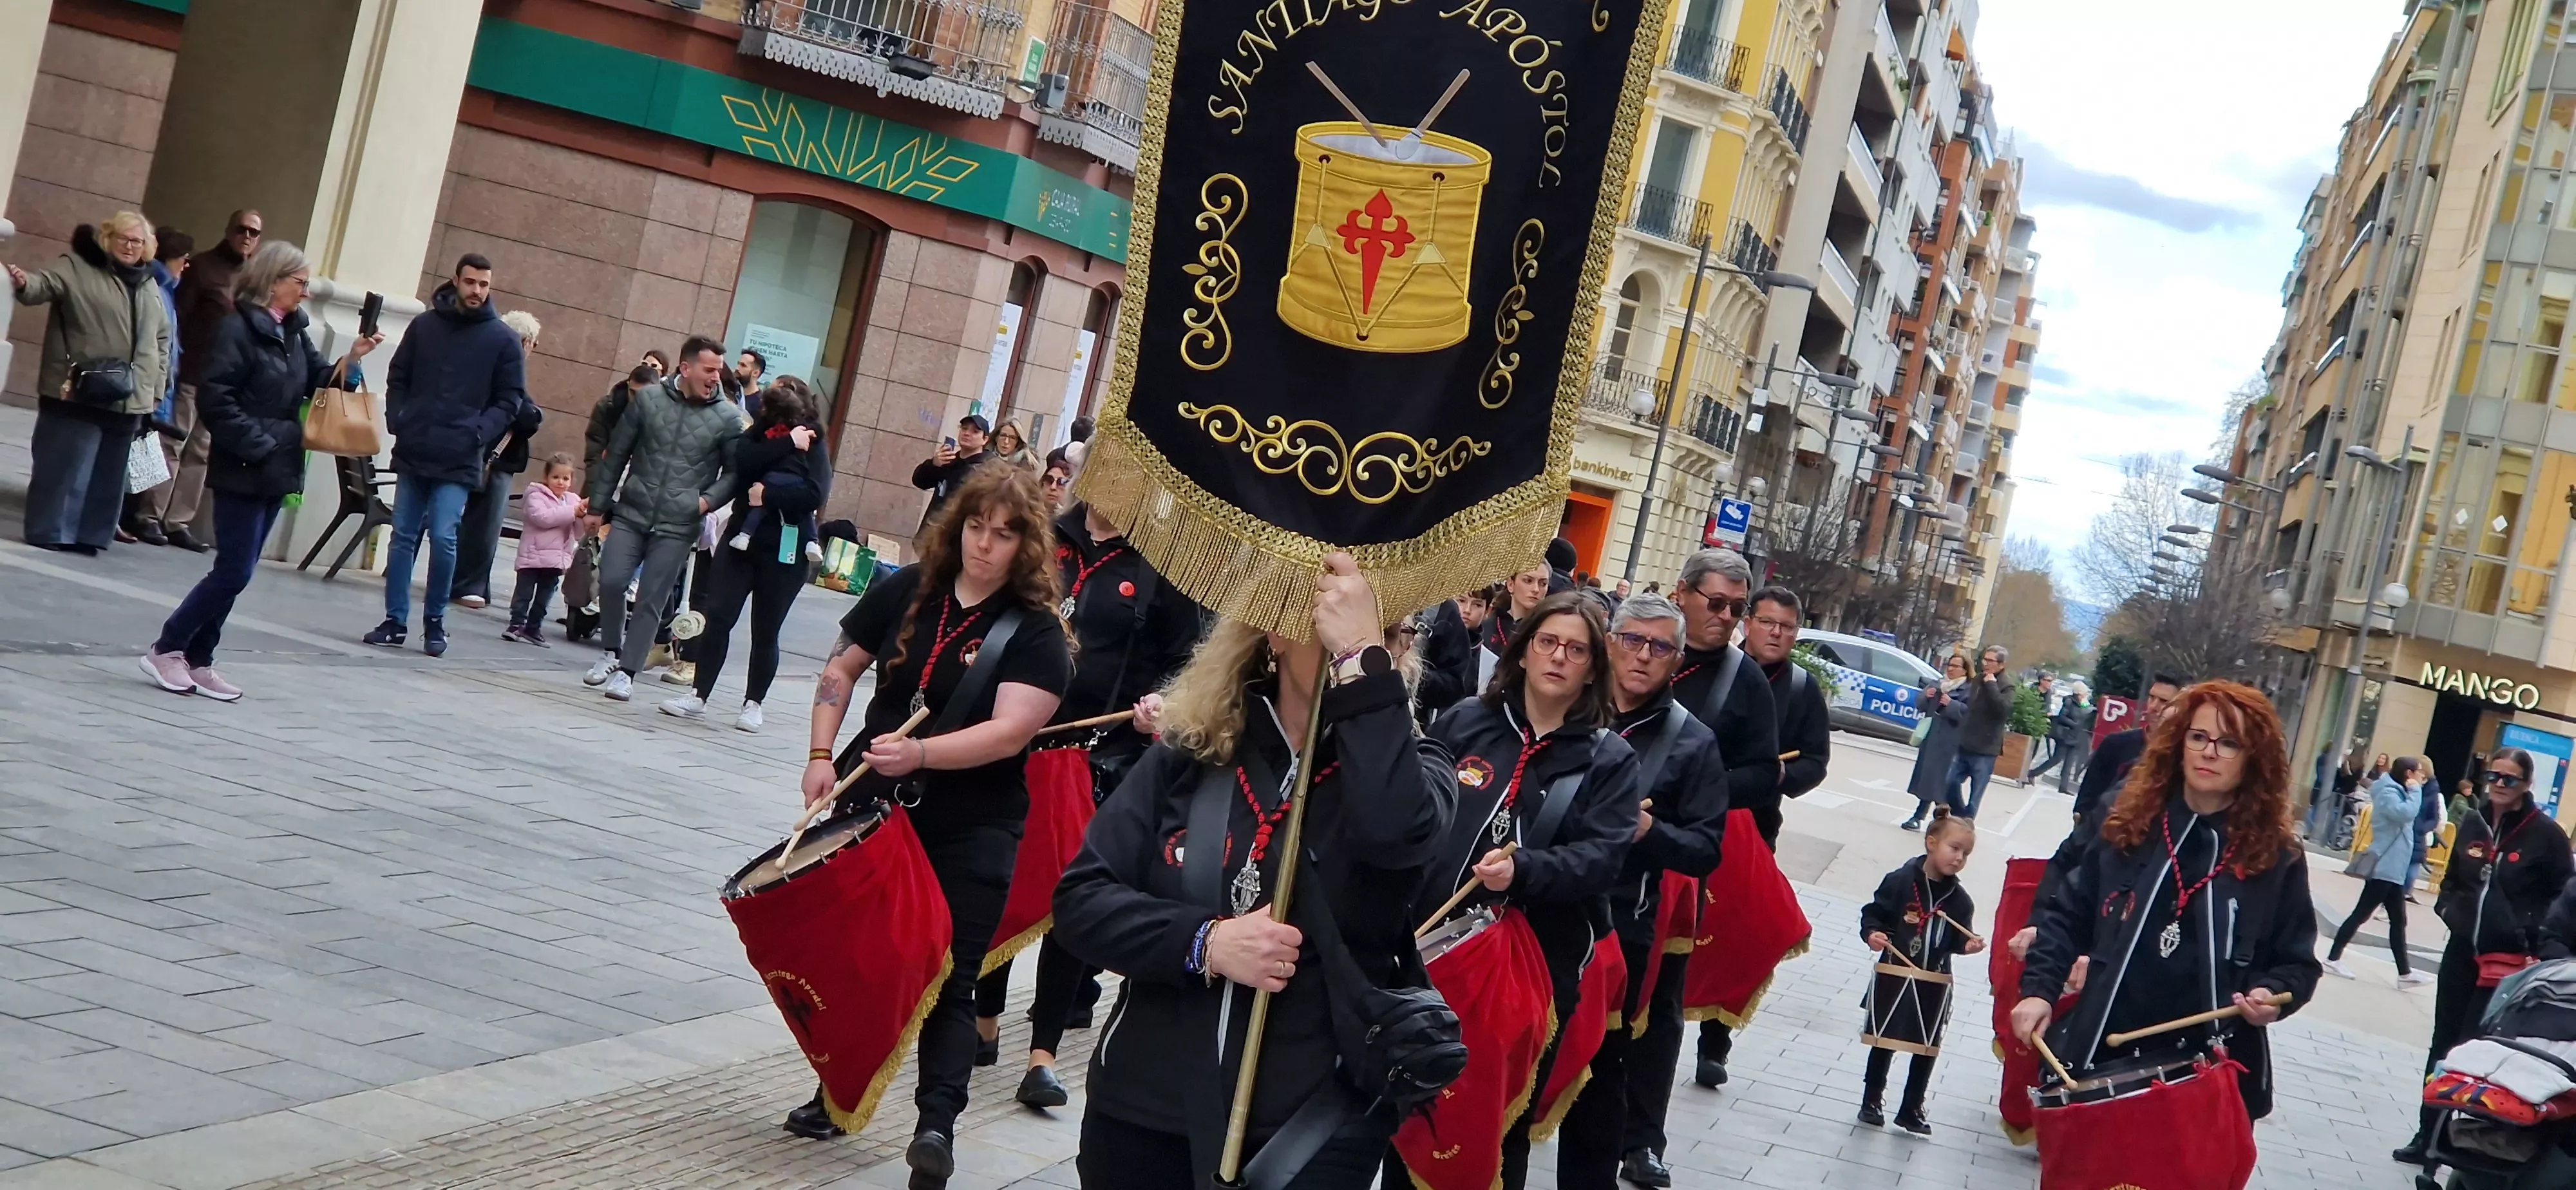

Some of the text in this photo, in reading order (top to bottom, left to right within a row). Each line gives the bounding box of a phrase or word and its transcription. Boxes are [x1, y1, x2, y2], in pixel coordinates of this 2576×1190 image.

[1208, 0, 1569, 188] SANTIAG APÓSTOL
[2420, 662, 2539, 710] MANGO
